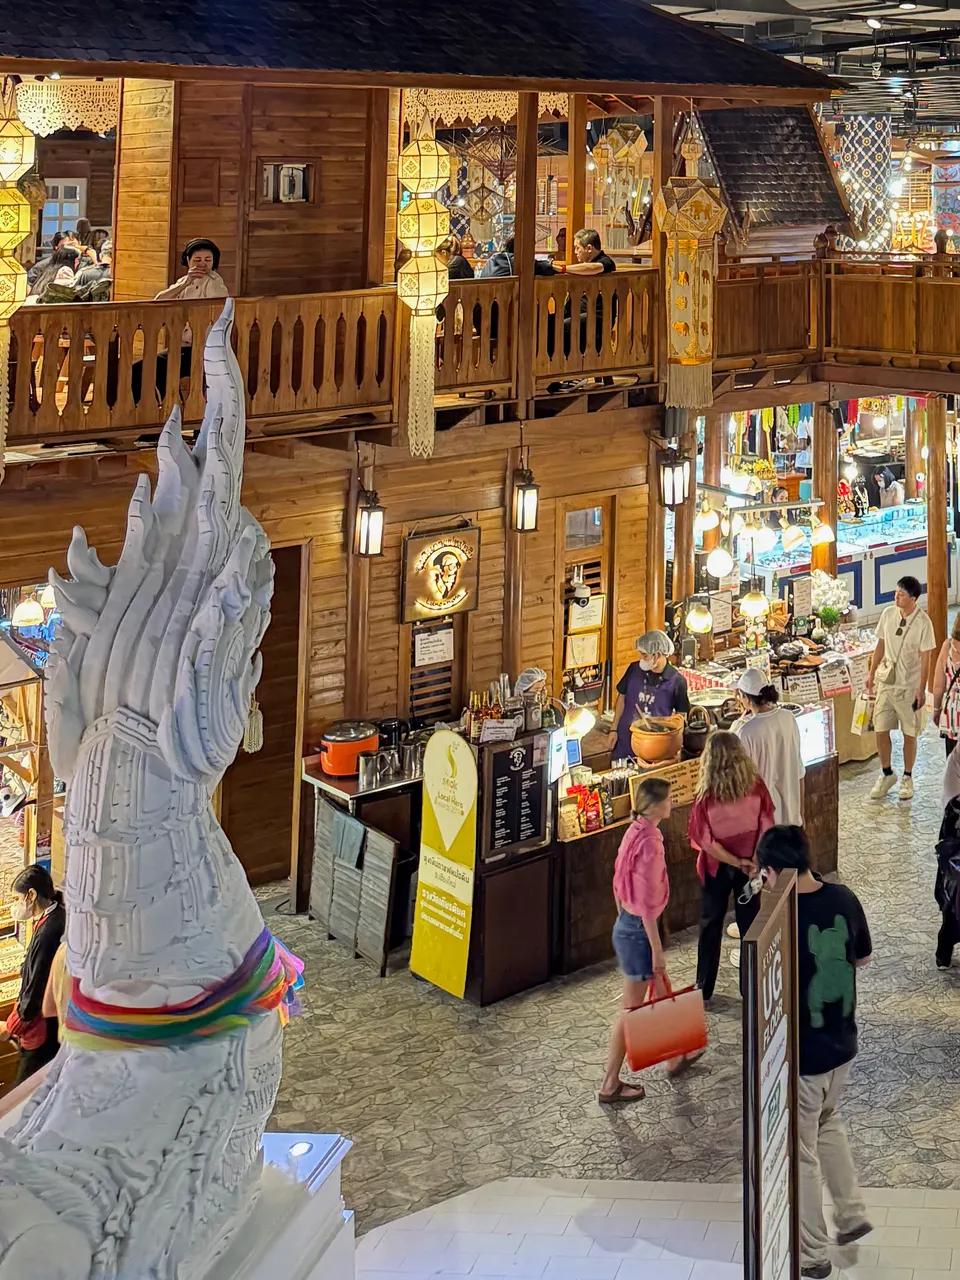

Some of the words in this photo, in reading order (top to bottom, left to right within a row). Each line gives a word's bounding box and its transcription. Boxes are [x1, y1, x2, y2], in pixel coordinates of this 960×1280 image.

[437, 791, 451, 803] Local
[762, 949, 783, 1021] UG
[762, 997, 783, 1052] FLOOR
